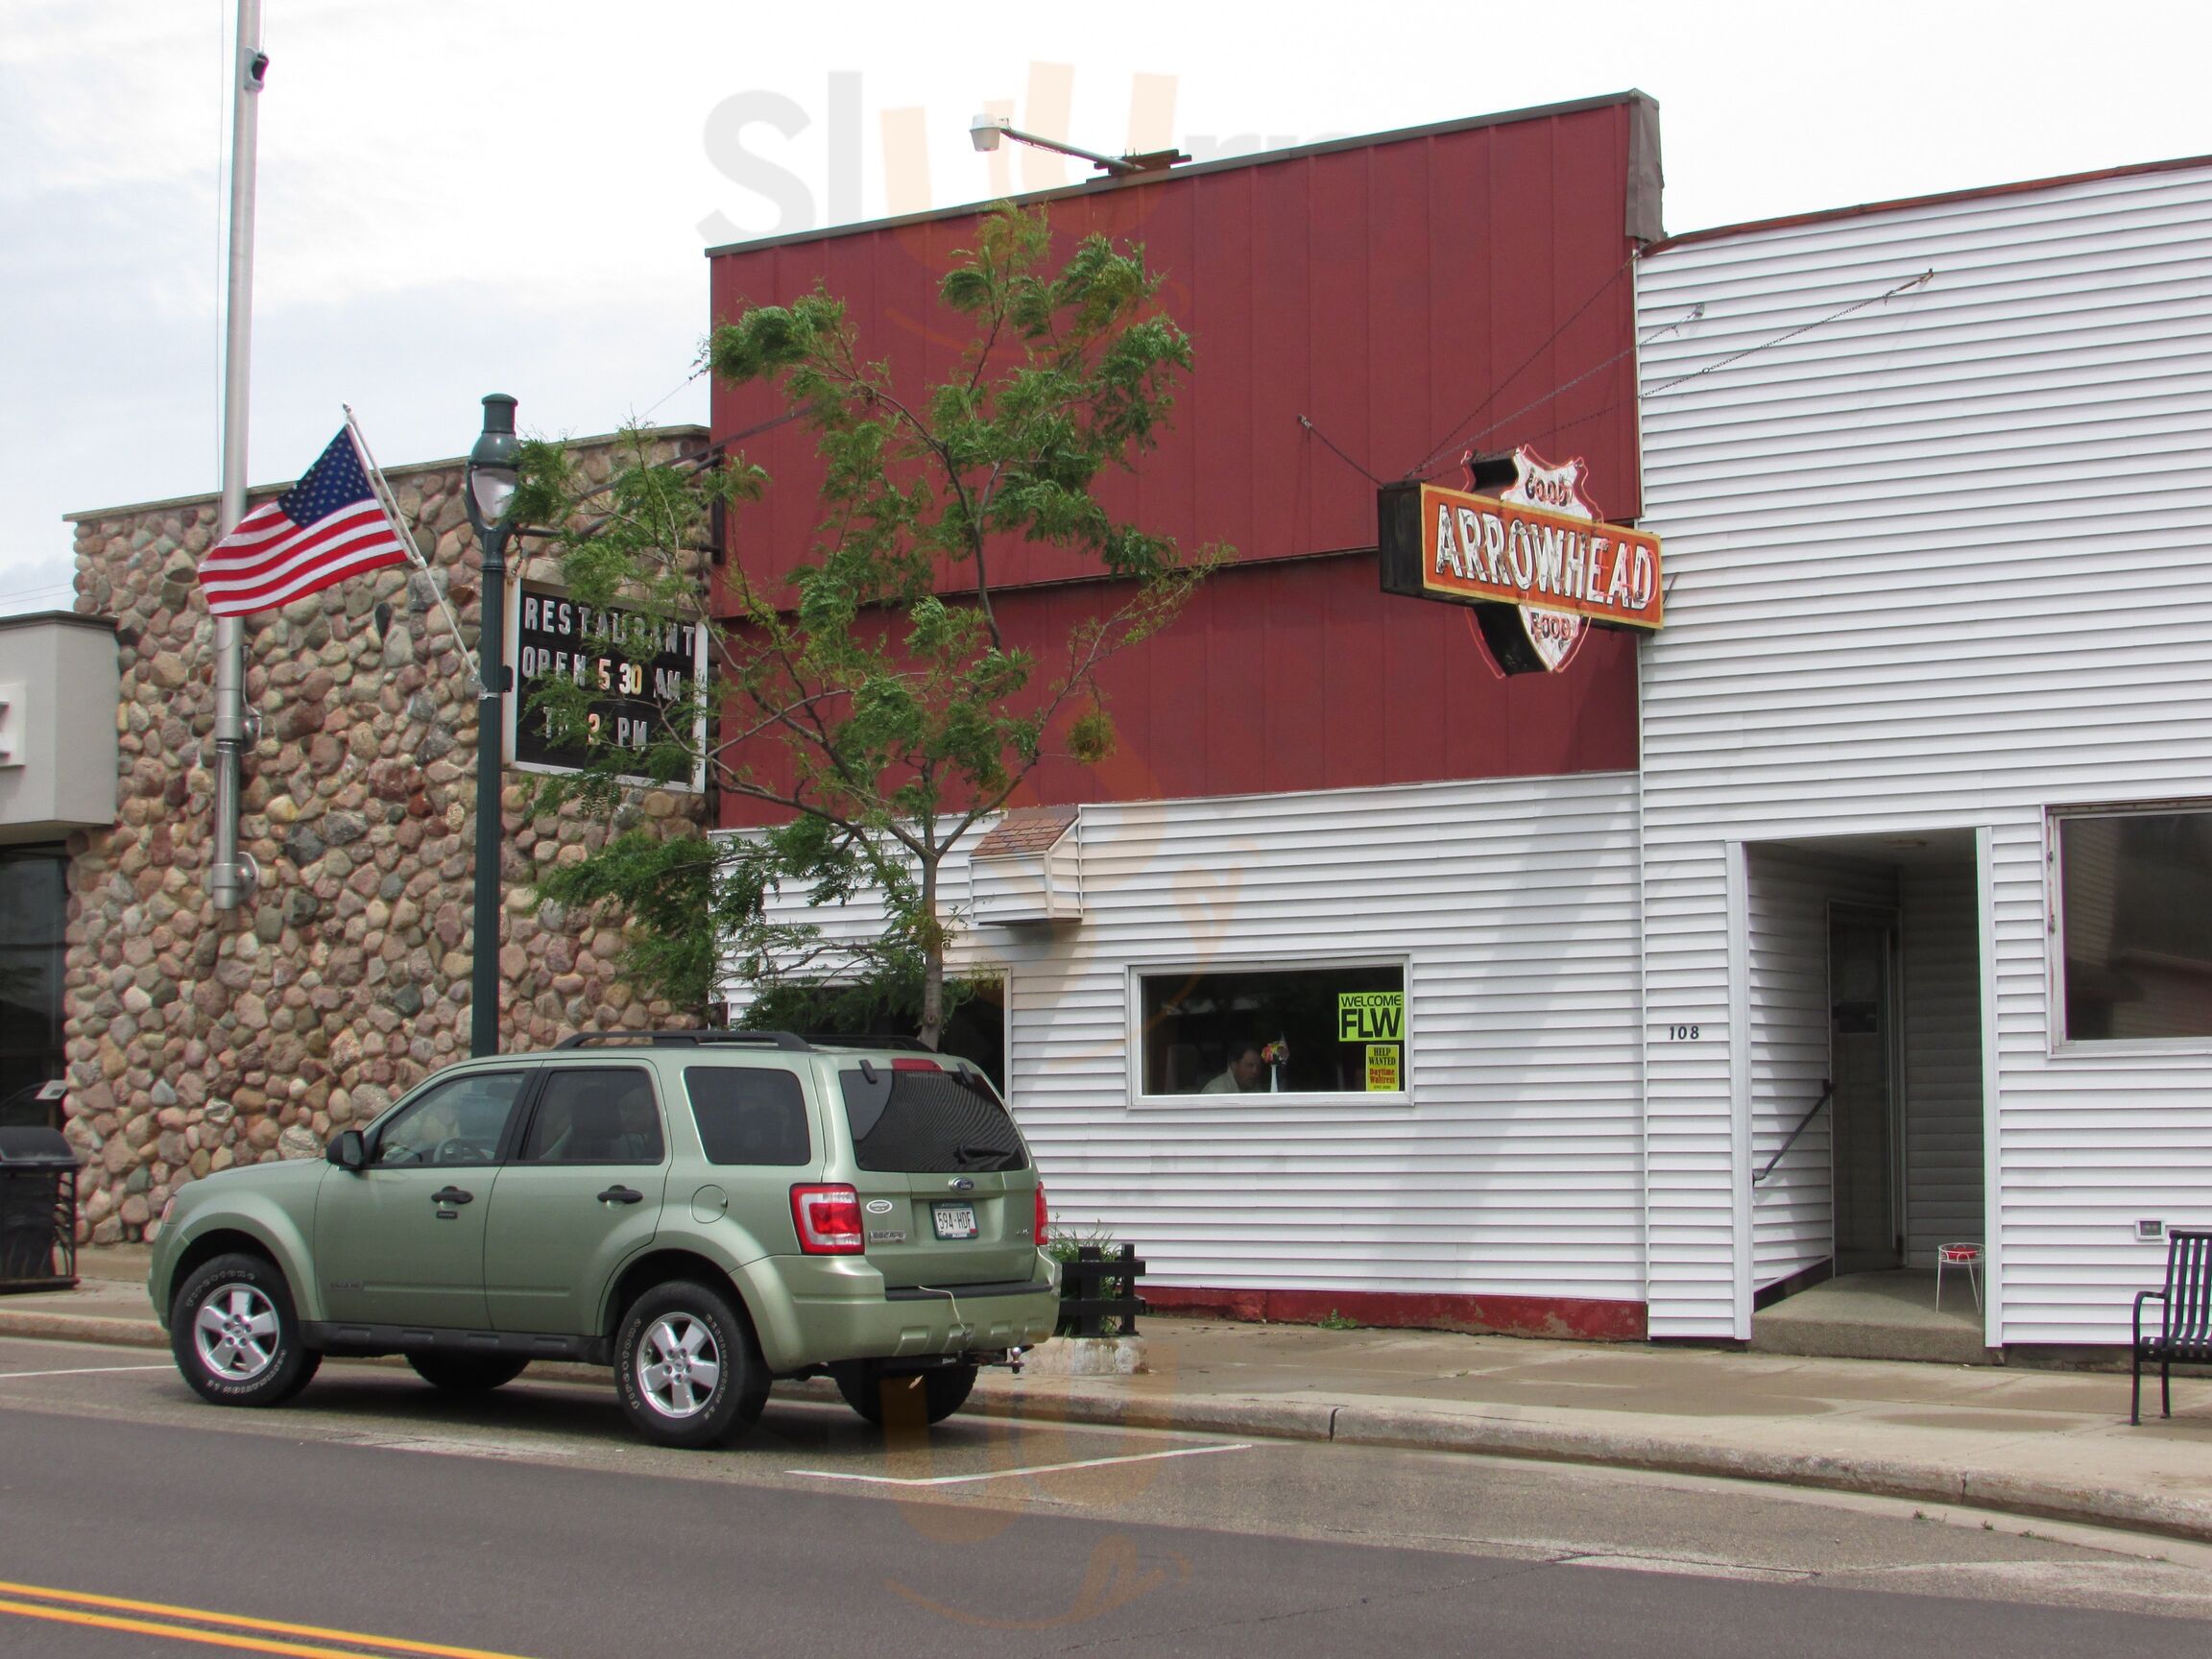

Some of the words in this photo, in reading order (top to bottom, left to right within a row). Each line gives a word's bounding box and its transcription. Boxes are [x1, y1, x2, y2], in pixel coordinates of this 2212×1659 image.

[1435, 503, 1654, 612] ARROWHEAD
[522, 645, 587, 688] OPEN
[597, 658, 612, 691] 5
[619, 662, 643, 695] 30
[653, 667, 681, 702] AM
[587, 712, 601, 747] 2
[617, 716, 648, 752] PM
[1340, 995, 1402, 1007] WELCOME
[1340, 1007, 1402, 1039] FLW
[1670, 1025, 1699, 1041] 108
[1368, 1057, 1396, 1066] WANTED
[1373, 1047, 1391, 1057] HELP
